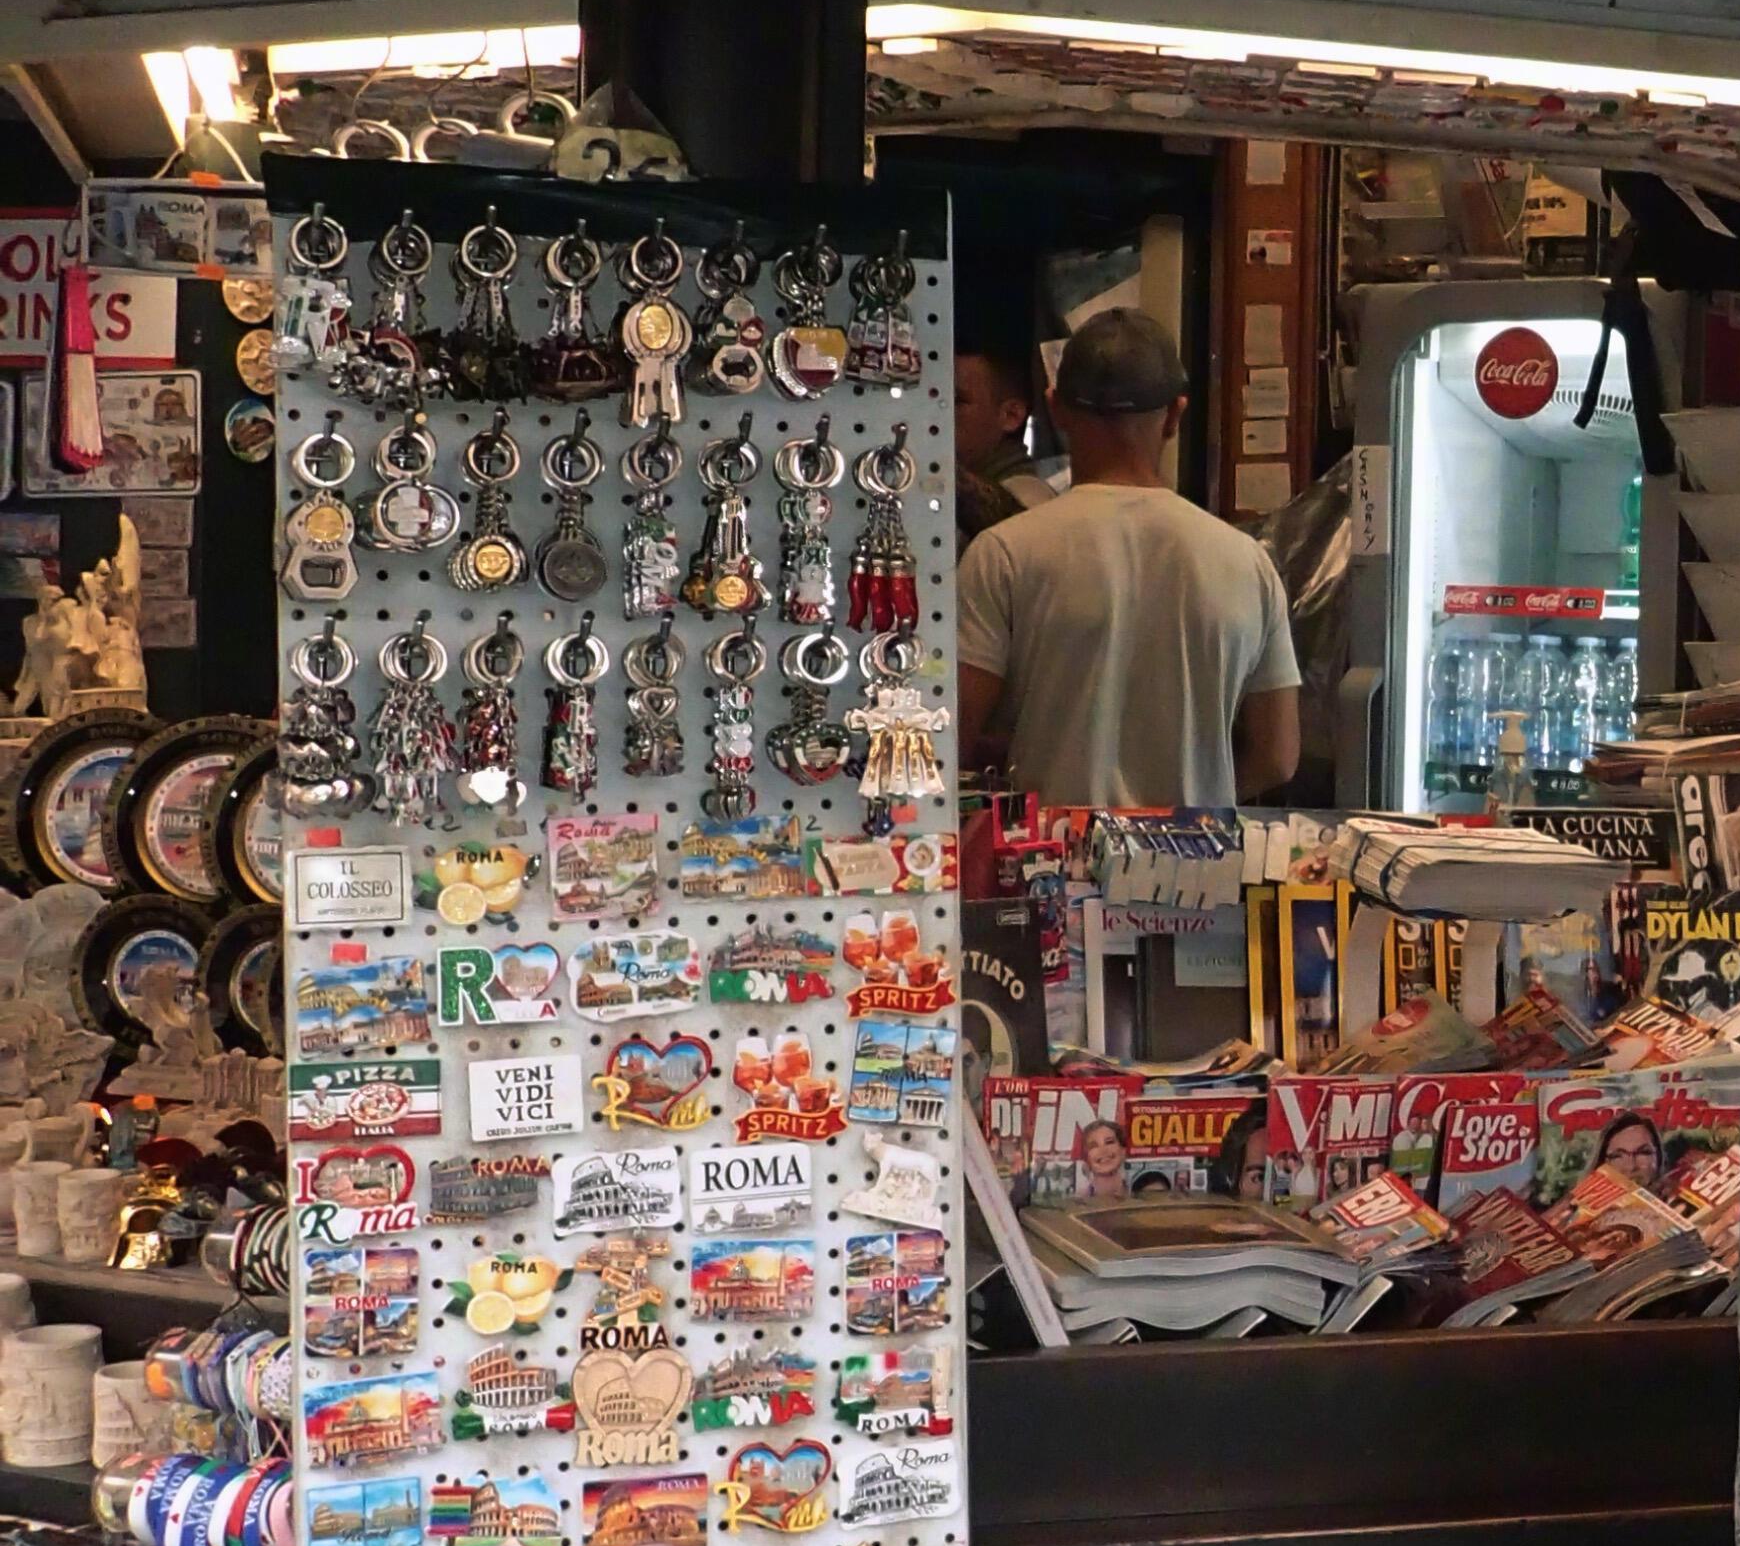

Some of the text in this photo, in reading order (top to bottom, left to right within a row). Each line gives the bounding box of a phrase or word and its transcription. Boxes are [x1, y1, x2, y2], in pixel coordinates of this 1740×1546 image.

[1562, 815, 1655, 837] CUCINA
[340, 860, 360, 875] IL
[455, 849, 505, 864] ROMA
[306, 879, 394, 900] COLOSSEO
[1125, 909, 1215, 934] Scienze
[1646, 909, 1730, 940] DYLAN
[617, 962, 673, 984] Roma
[858, 988, 939, 1011] SPRITZ
[335, 1065, 417, 1085] PIZZA
[495, 1064, 555, 1084] VENI
[495, 1084, 555, 1103] VIDI
[495, 1103, 555, 1123] VICI
[747, 1113, 828, 1135] SPRITZ
[1451, 1108, 1518, 1139] Love
[1459, 1135, 1536, 1166] Story
[475, 1155, 550, 1178] ROMA
[616, 1153, 674, 1174] Roma
[701, 1154, 806, 1194] ROMA
[489, 1259, 539, 1275] ROMA
[870, 1275, 921, 1292] ROMA
[334, 1294, 391, 1311] ROMA
[580, 1325, 669, 1351] ROMA
[861, 1412, 928, 1434] ROMA
[896, 1447, 951, 1471] Roma
